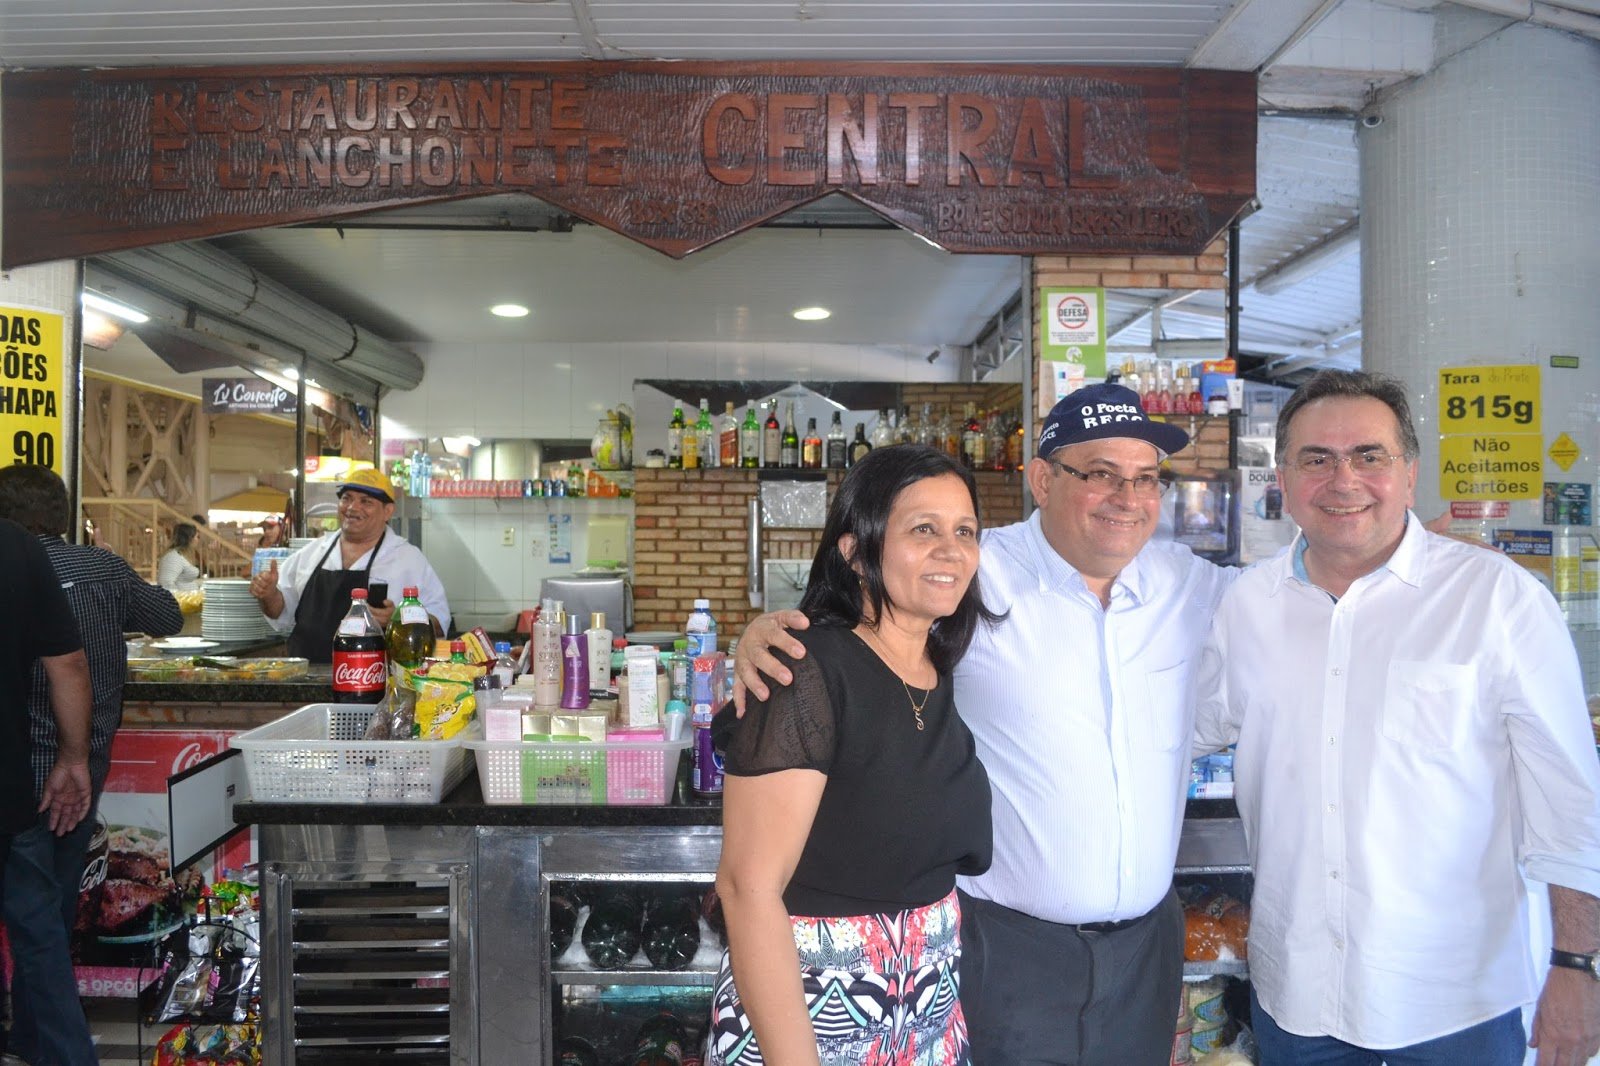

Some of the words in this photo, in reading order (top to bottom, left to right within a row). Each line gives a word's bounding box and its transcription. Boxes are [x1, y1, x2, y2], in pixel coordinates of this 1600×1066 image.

[150, 78, 588, 133] RESTAURANTE
[703, 92, 1123, 190] CENTRAL
[151, 136, 190, 191] E
[217, 135, 625, 189] LANCHONETE
[1058, 308, 1089, 317] DEFESA
[0, 345, 48, 382] ÕES
[1442, 373, 1480, 384] Tara
[232, 383, 288, 407] Conceito
[1081, 405, 1094, 417] O
[1096, 403, 1138, 414] Poeta
[1446, 395, 1533, 424] 815g
[13, 430, 54, 470] 90
[1473, 438, 1511, 453] Não
[1443, 459, 1540, 474] Aceitamos
[1455, 479, 1529, 494] Cartões
